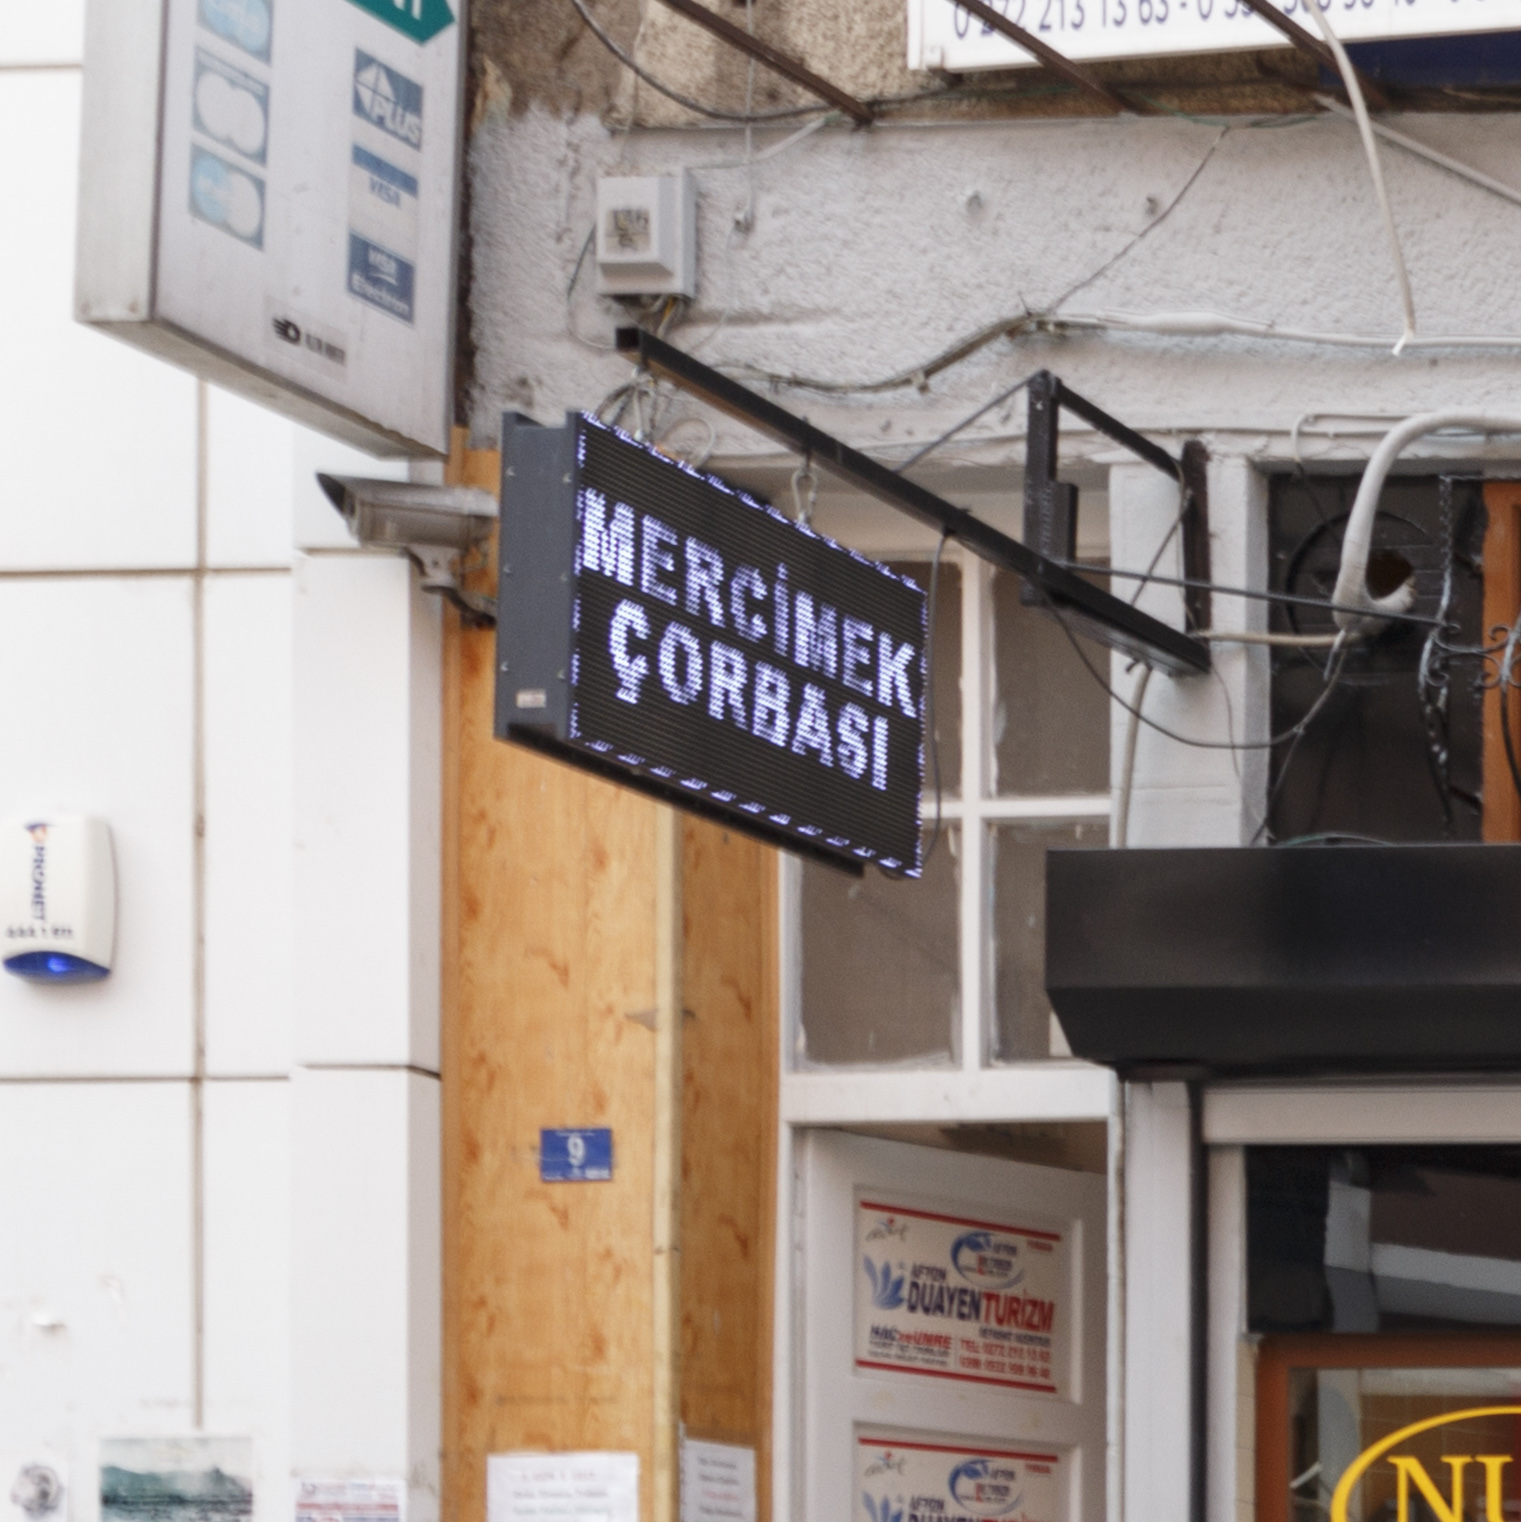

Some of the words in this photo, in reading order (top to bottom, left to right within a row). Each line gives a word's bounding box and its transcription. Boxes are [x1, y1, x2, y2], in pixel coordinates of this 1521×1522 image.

[582, 487, 917, 719] MERCİMEK
[609, 598, 889, 791] ÇORBASI
[566, 1132, 586, 1168] 9
[907, 1281, 981, 1321] DUAYEN
[982, 1288, 1055, 1334] TURİZM
